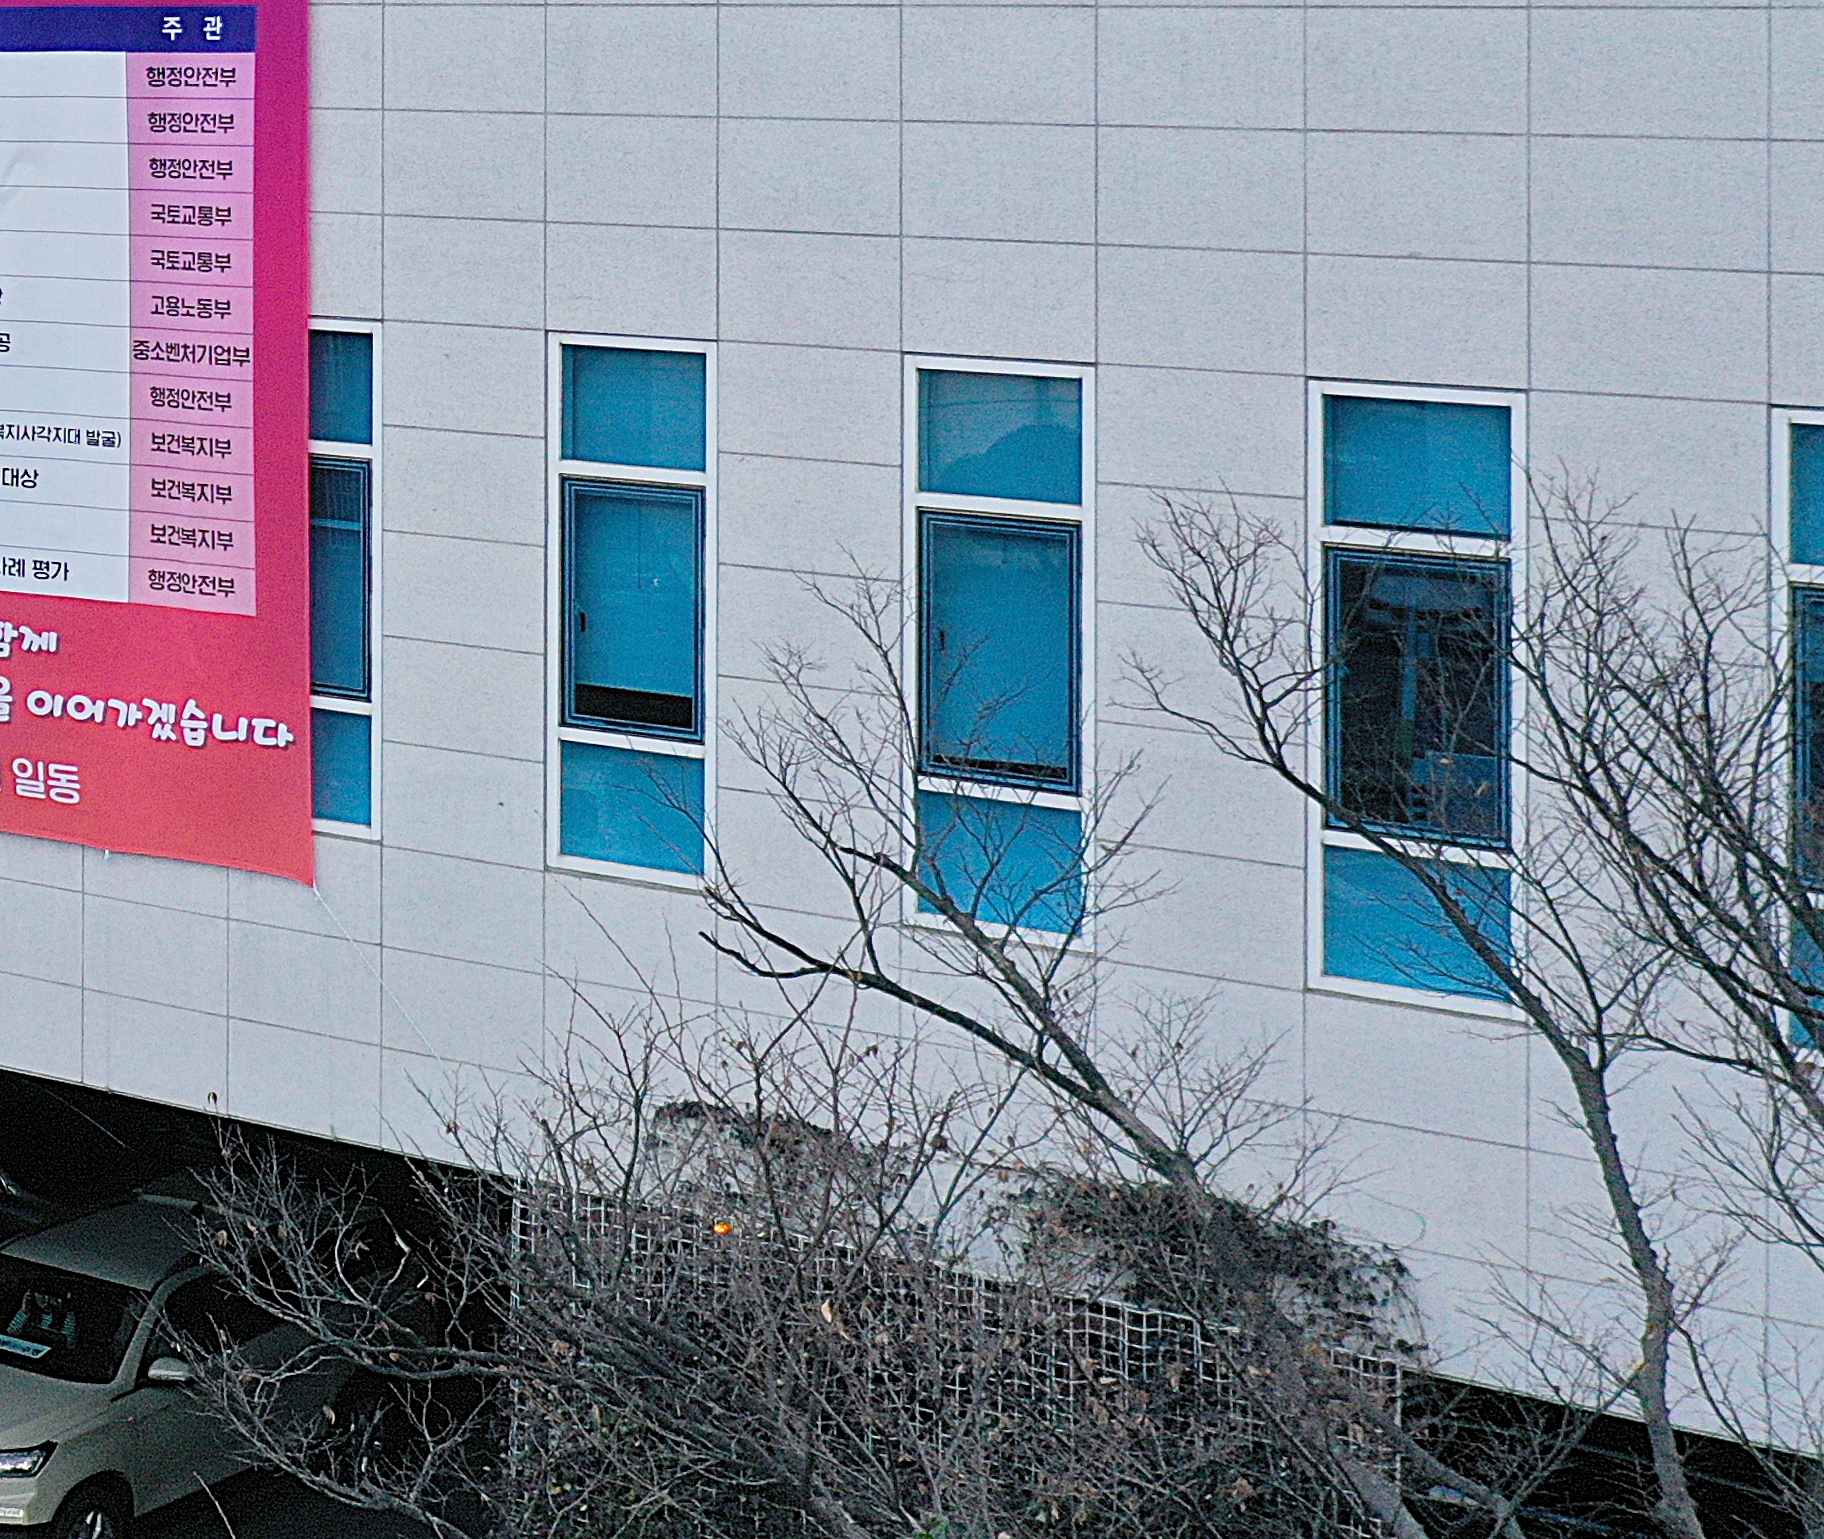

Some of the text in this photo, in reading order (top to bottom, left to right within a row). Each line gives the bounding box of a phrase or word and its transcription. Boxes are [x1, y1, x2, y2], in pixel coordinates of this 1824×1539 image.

[144, 63, 237, 89] 행정안전부
[147, 110, 235, 135] 행정안전부
[148, 156, 234, 182] 행정안전부
[150, 203, 232, 227] 국토교통부
[150, 250, 232, 273] 국토교통부
[150, 296, 231, 320] 고용노동부
[132, 340, 251, 367] 중소벤처기업부
[150, 387, 232, 411] 행정안전부
[85, 427, 122, 449] 발굴)
[150, 432, 231, 456] 보건복지부
[151, 479, 232, 502] 보건복지부
[150, 525, 233, 550] 보건복지부
[31, 555, 70, 581] 평가
[148, 570, 235, 596] 행정안전부
[27, 687, 294, 749] 이어가겠습니다
[13, 757, 82, 801] 일동
